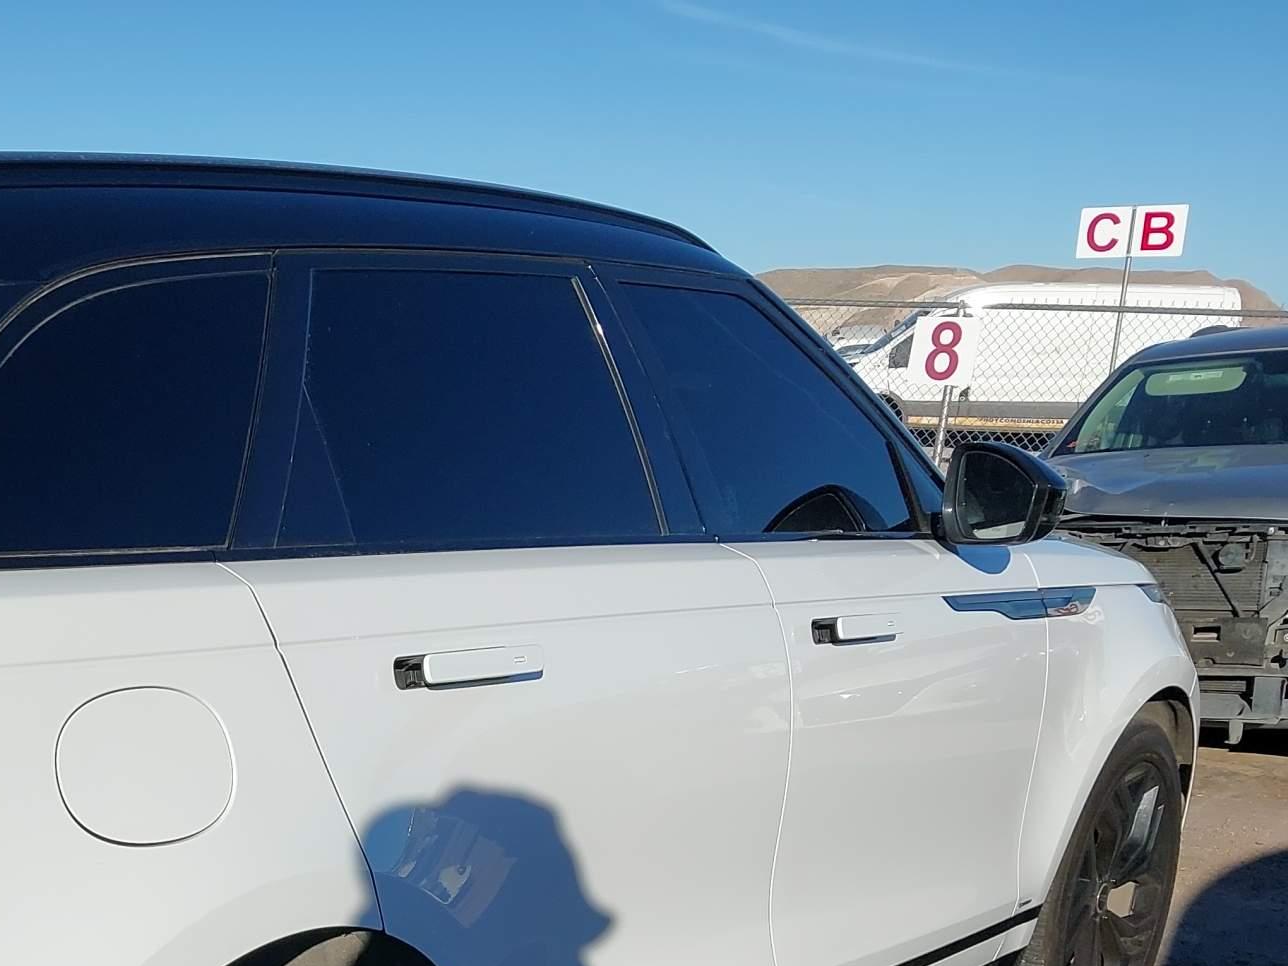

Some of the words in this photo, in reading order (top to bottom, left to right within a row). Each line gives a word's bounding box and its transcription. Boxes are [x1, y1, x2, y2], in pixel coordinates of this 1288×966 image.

[1087, 212, 1121, 252] C
[1140, 211, 1175, 251] B
[924, 321, 962, 381] 8
